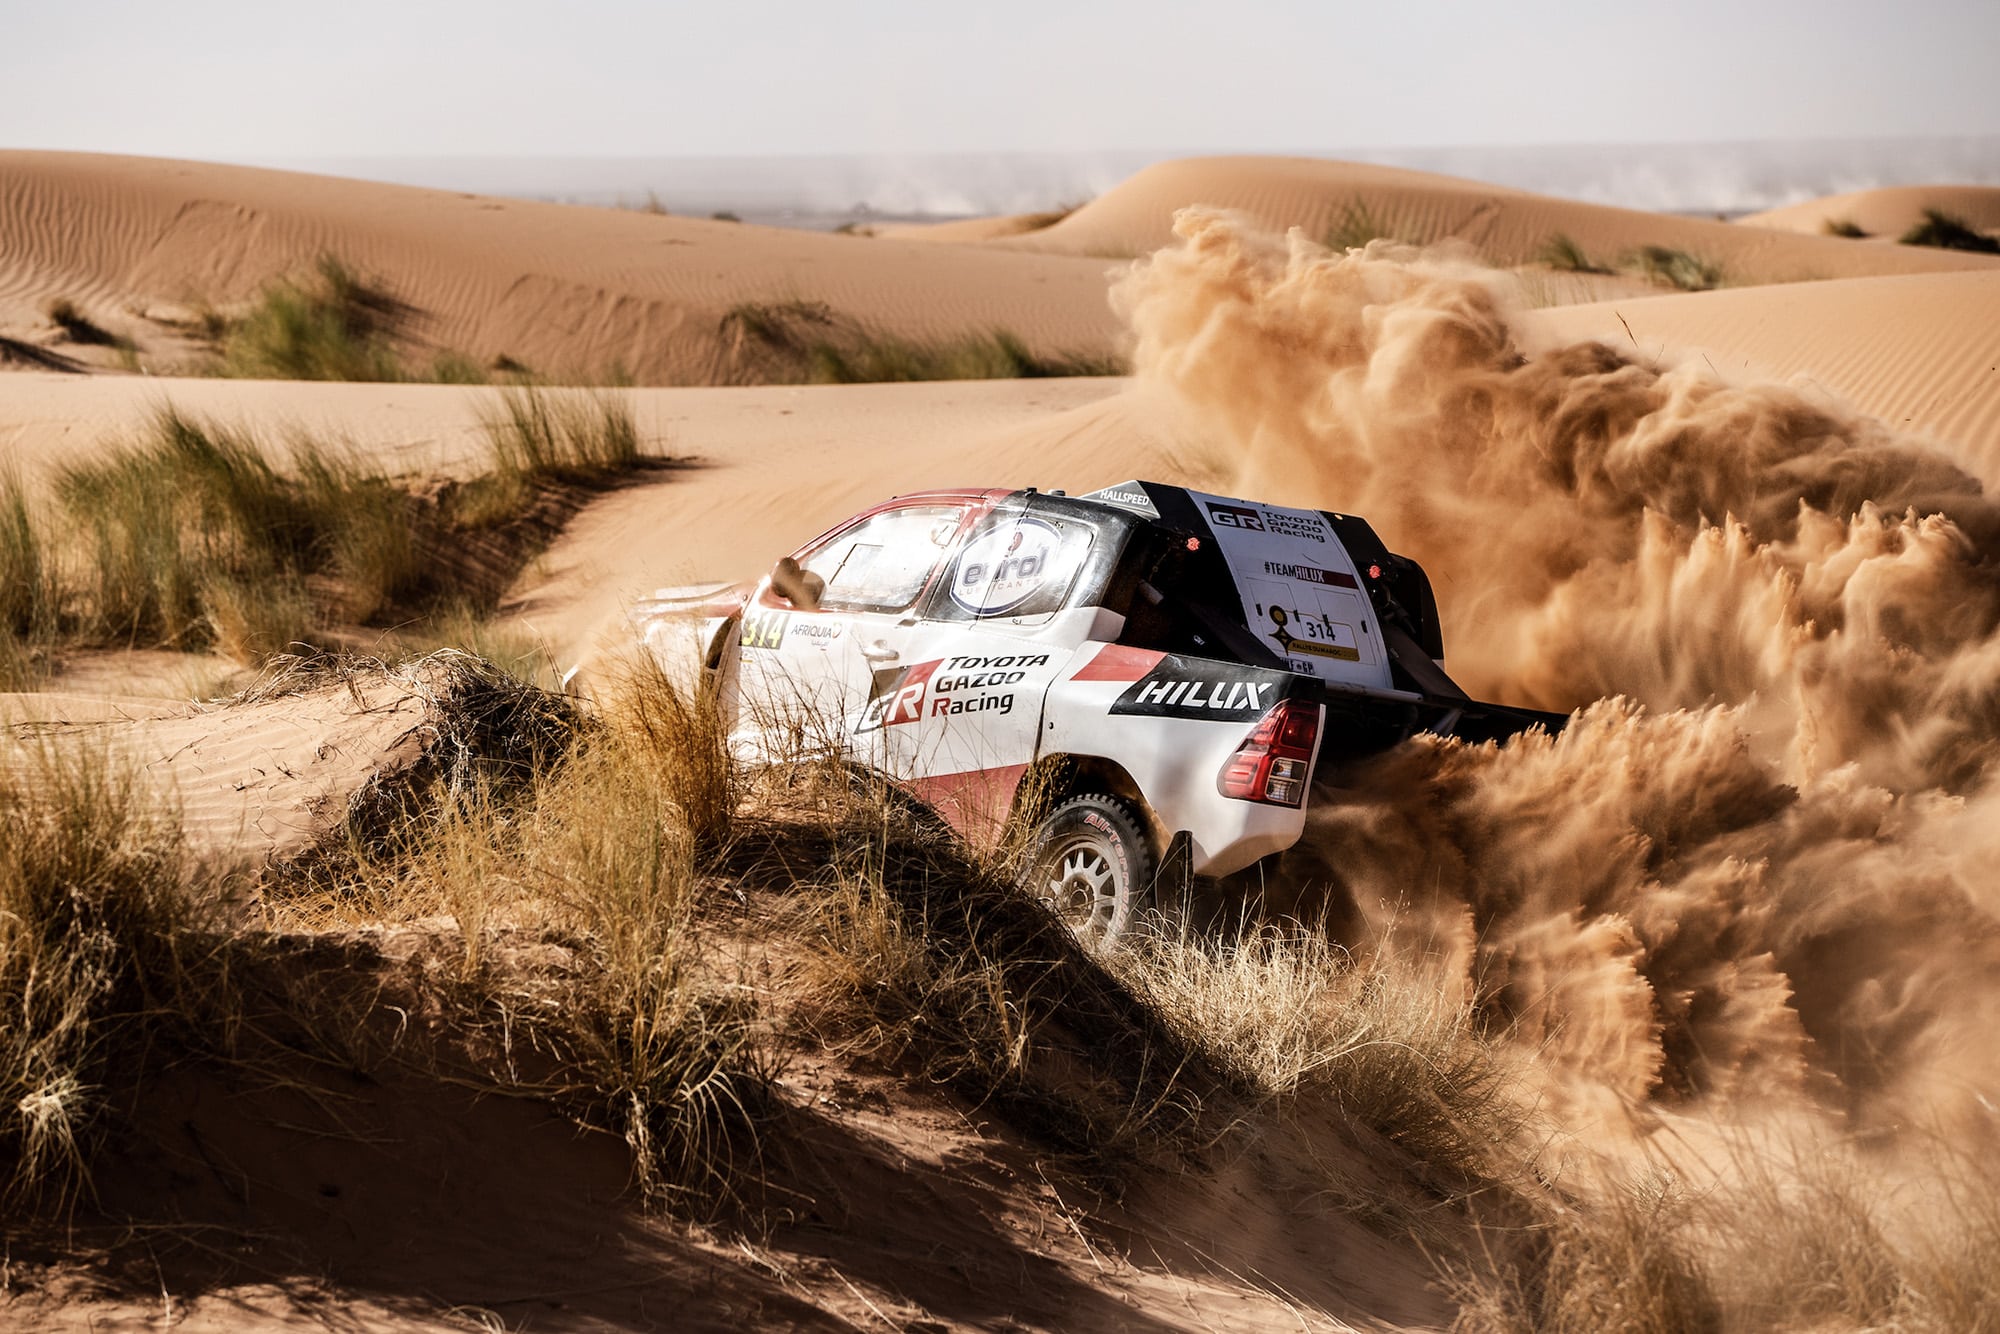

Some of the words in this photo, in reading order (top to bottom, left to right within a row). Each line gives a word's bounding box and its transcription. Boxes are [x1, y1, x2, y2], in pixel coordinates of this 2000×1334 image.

[1101, 489, 1150, 506] HALLSPEED
[1211, 510, 1263, 531] GR
[1262, 511, 1325, 526] TOYOTA
[1266, 519, 1323, 534] GAZOO
[1270, 526, 1326, 543] Racing
[1264, 561, 1325, 584] #TEAMHILUX
[742, 613, 781, 648] 314
[791, 624, 832, 639] AFRIQUIA
[1306, 621, 1336, 642] 314
[947, 654, 1050, 670] TOYOTA
[935, 671, 1026, 693] GAZOO
[931, 692, 1014, 718] Racing
[1134, 680, 1273, 710] HILUX
[857, 682, 926, 731] GR
